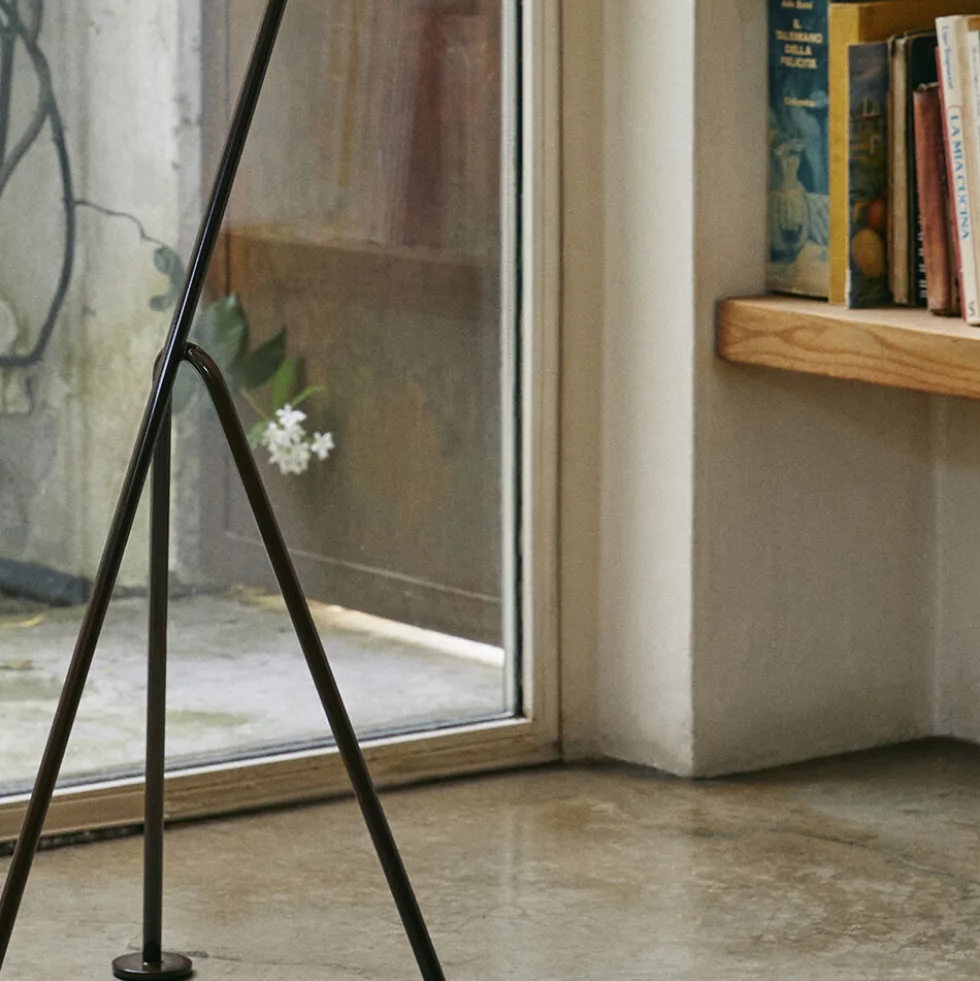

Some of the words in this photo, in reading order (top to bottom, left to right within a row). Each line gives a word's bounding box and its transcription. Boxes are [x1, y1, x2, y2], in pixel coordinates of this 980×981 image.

[950, 114, 962, 138] LA
[953, 139, 965, 172] MIA
[956, 174, 971, 241] CUCINA
